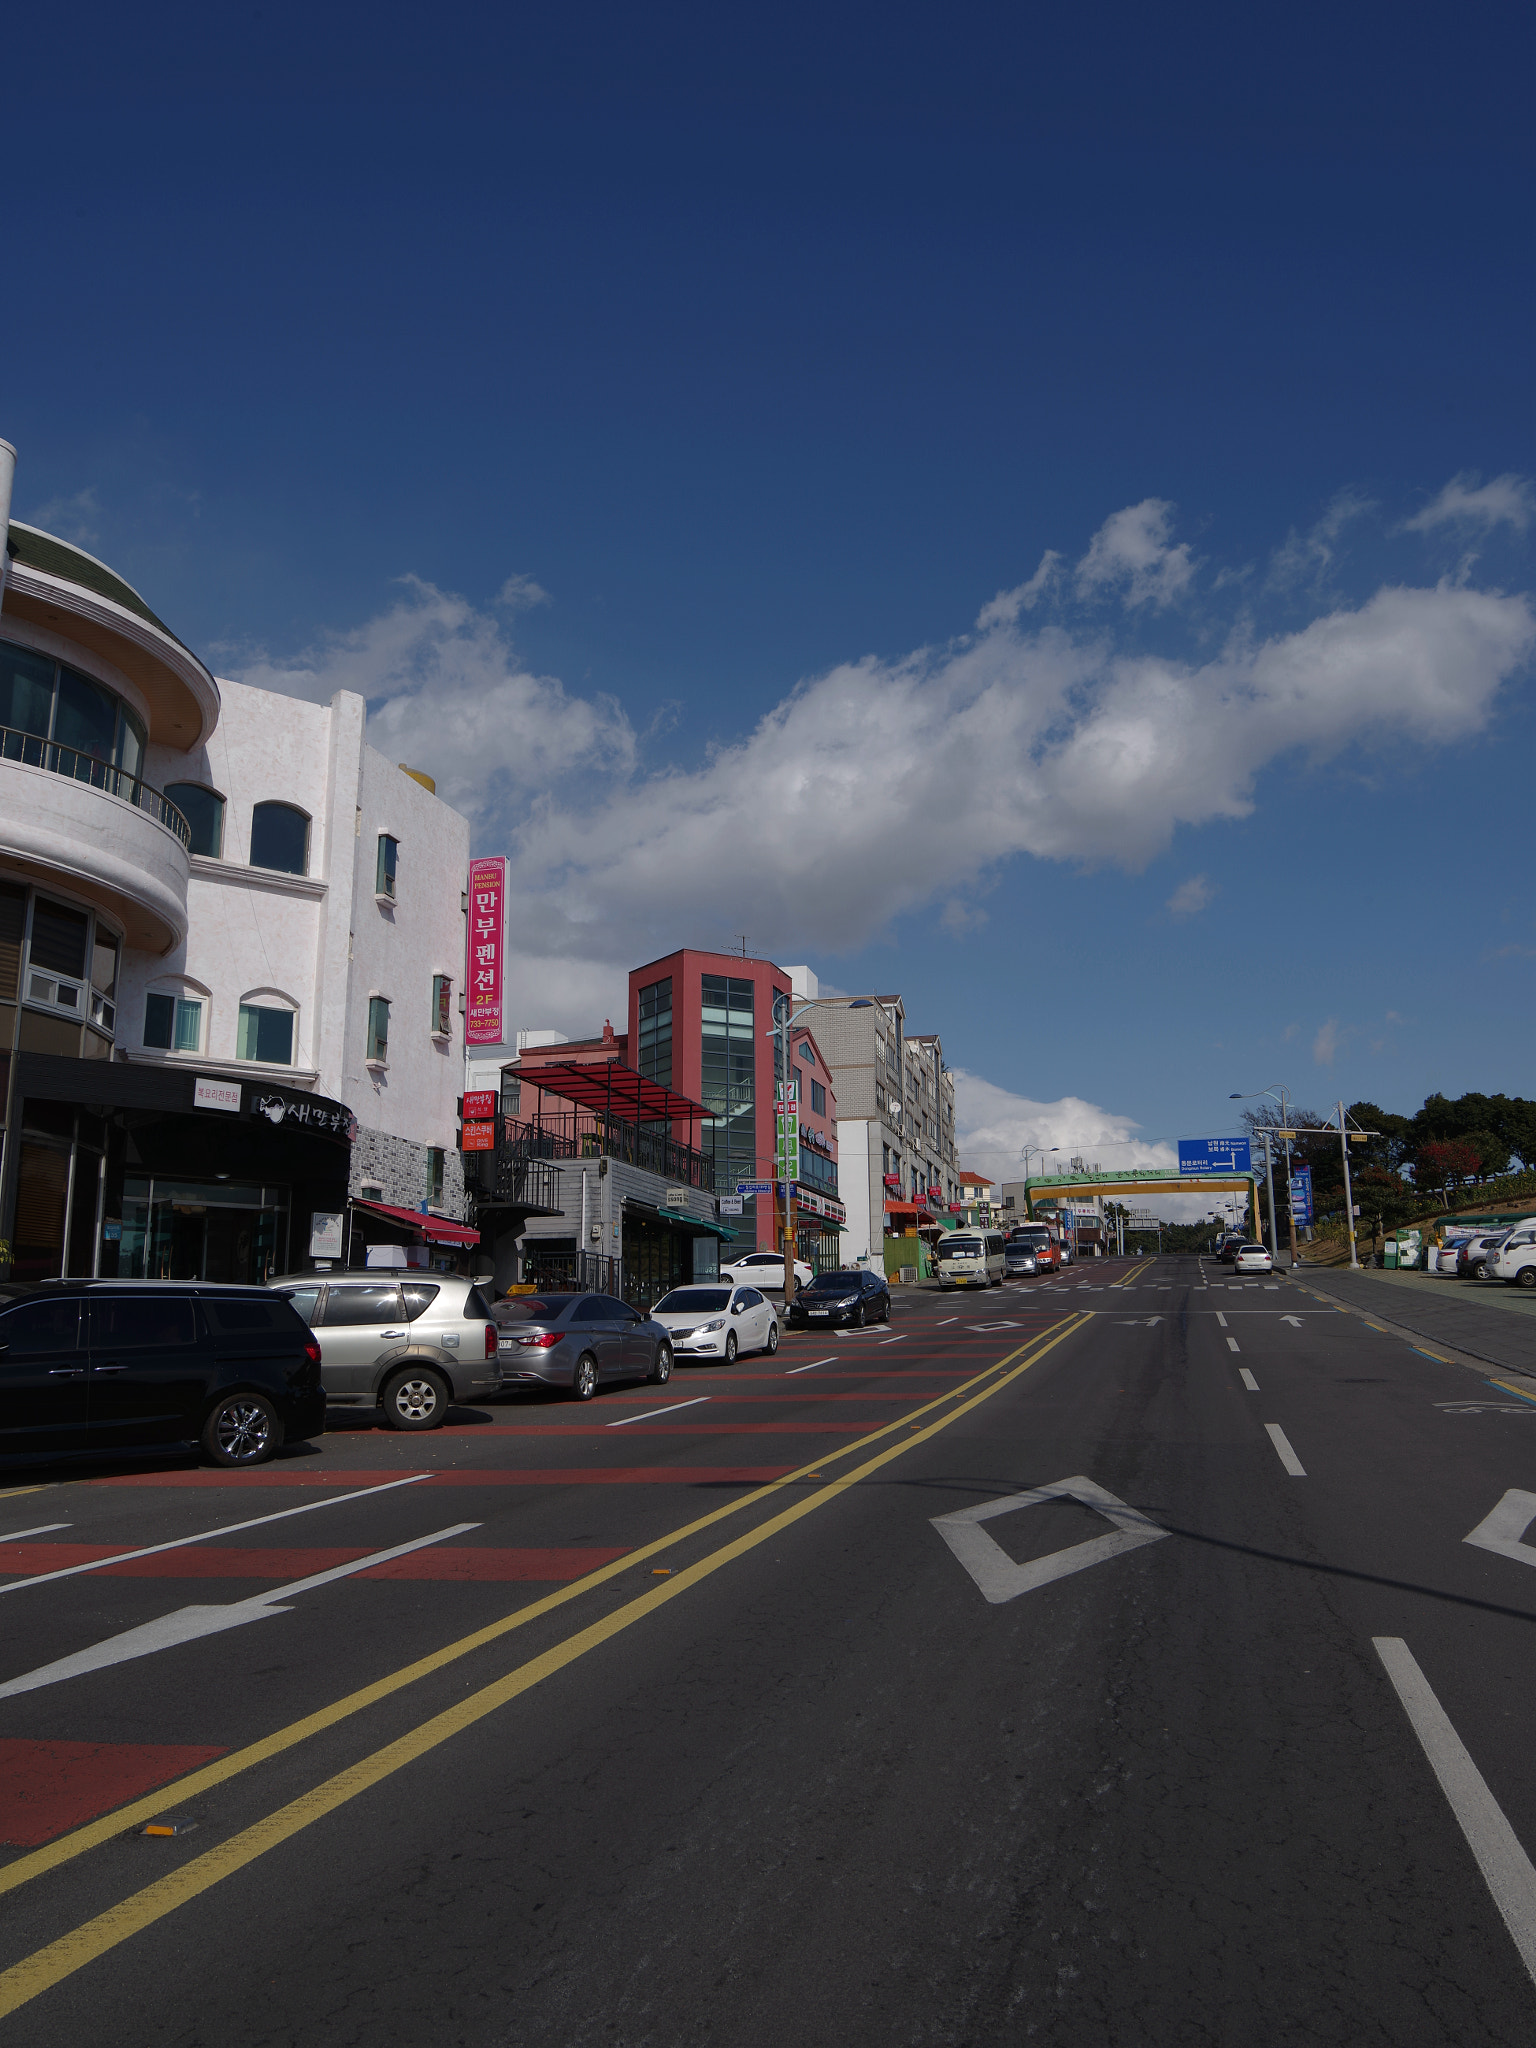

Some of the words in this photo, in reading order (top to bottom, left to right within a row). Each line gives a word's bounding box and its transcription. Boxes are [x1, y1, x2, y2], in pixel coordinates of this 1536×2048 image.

[474, 873, 497, 881] MANBU
[474, 881, 501, 889] PENSION
[474, 891, 498, 991] 만부펜션
[476, 994, 493, 1005] 2F
[470, 1007, 499, 1018] 새만부정
[470, 1018, 499, 1028] 733-7750
[197, 1087, 238, 1104] 복요리전문점
[465, 1124, 493, 1136] 스킨스쿠버
